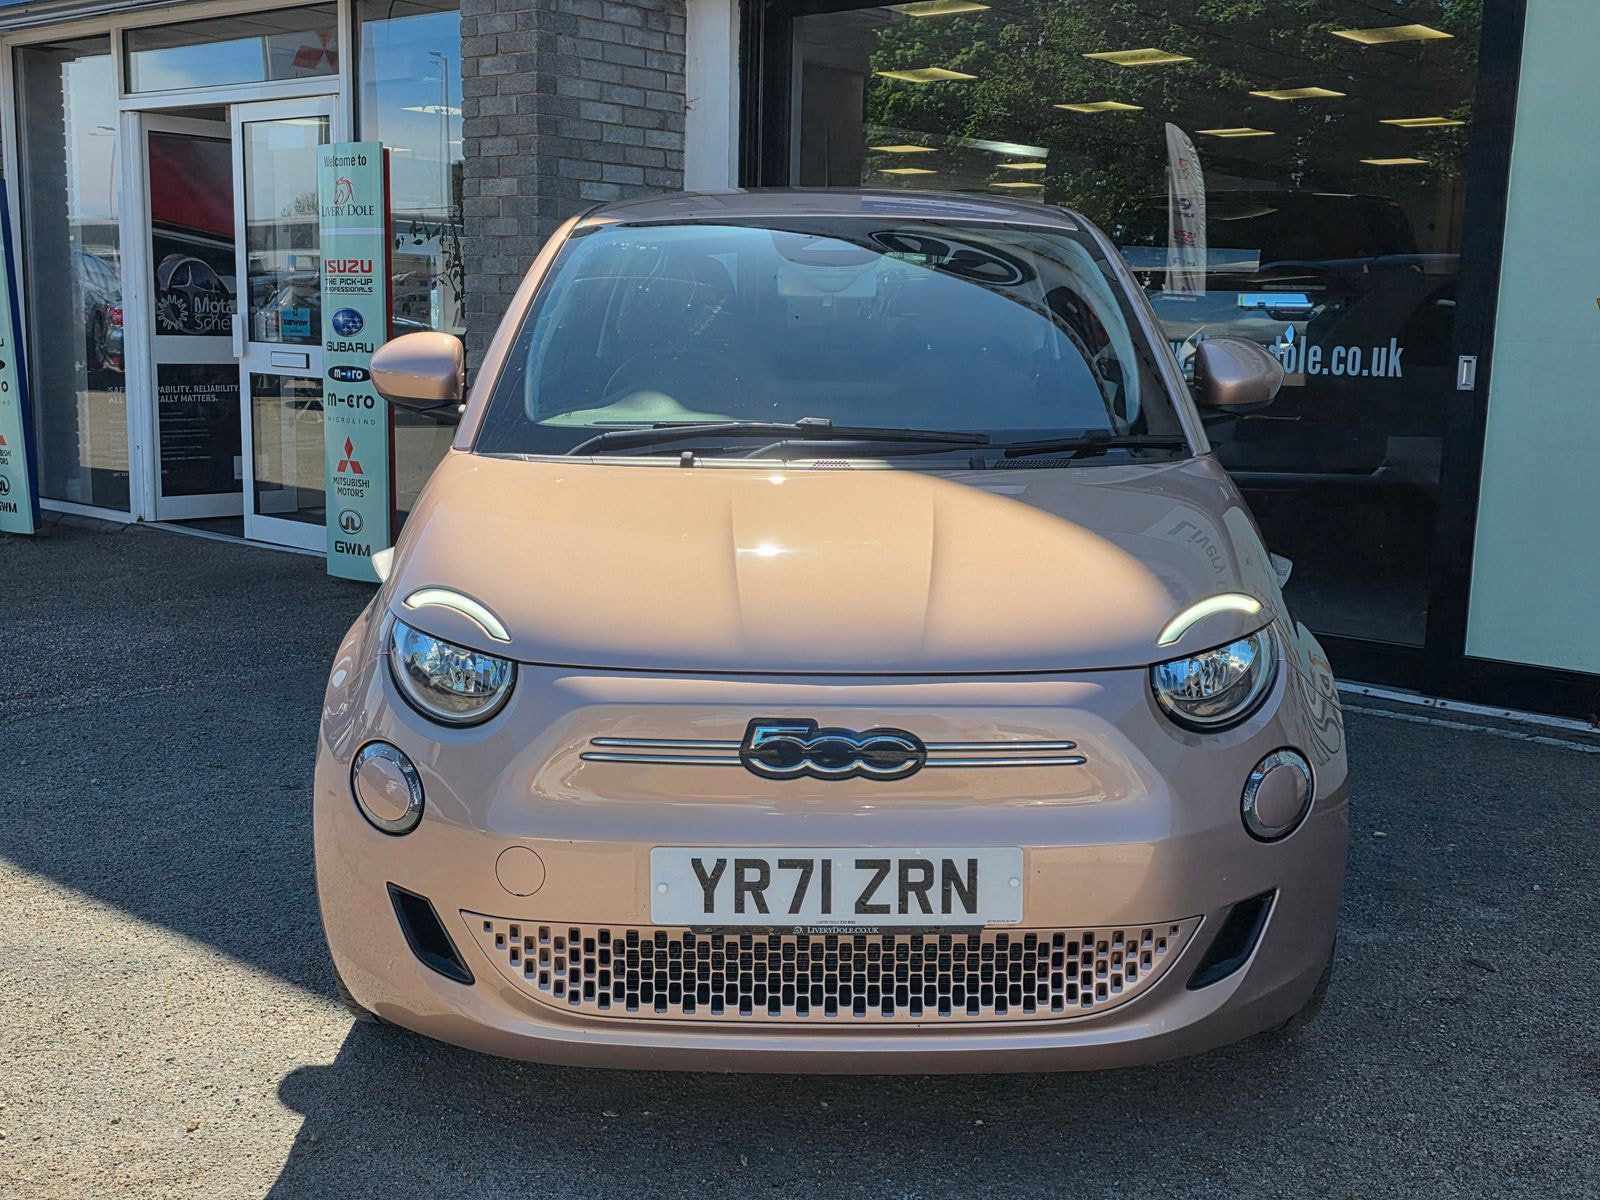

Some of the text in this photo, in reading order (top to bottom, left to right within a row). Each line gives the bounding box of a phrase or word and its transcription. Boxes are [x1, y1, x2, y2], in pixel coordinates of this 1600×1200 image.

[324, 154, 367, 167] Welcome to
[321, 204, 375, 217] LIVERY DOLE
[325, 259, 373, 273] ISUZU
[325, 278, 373, 286] THE PICK-UP
[194, 296, 233, 313] Mota
[194, 315, 231, 330] Sche
[327, 341, 375, 354] SUBARU
[328, 416, 376, 425] MICROLINO
[333, 477, 370, 488] MITSUBISHI
[337, 487, 365, 498] MOTORS
[334, 540, 371, 556] GWM
[745, 722, 921, 777] 500
[690, 858, 978, 914] YR71 ZRN
